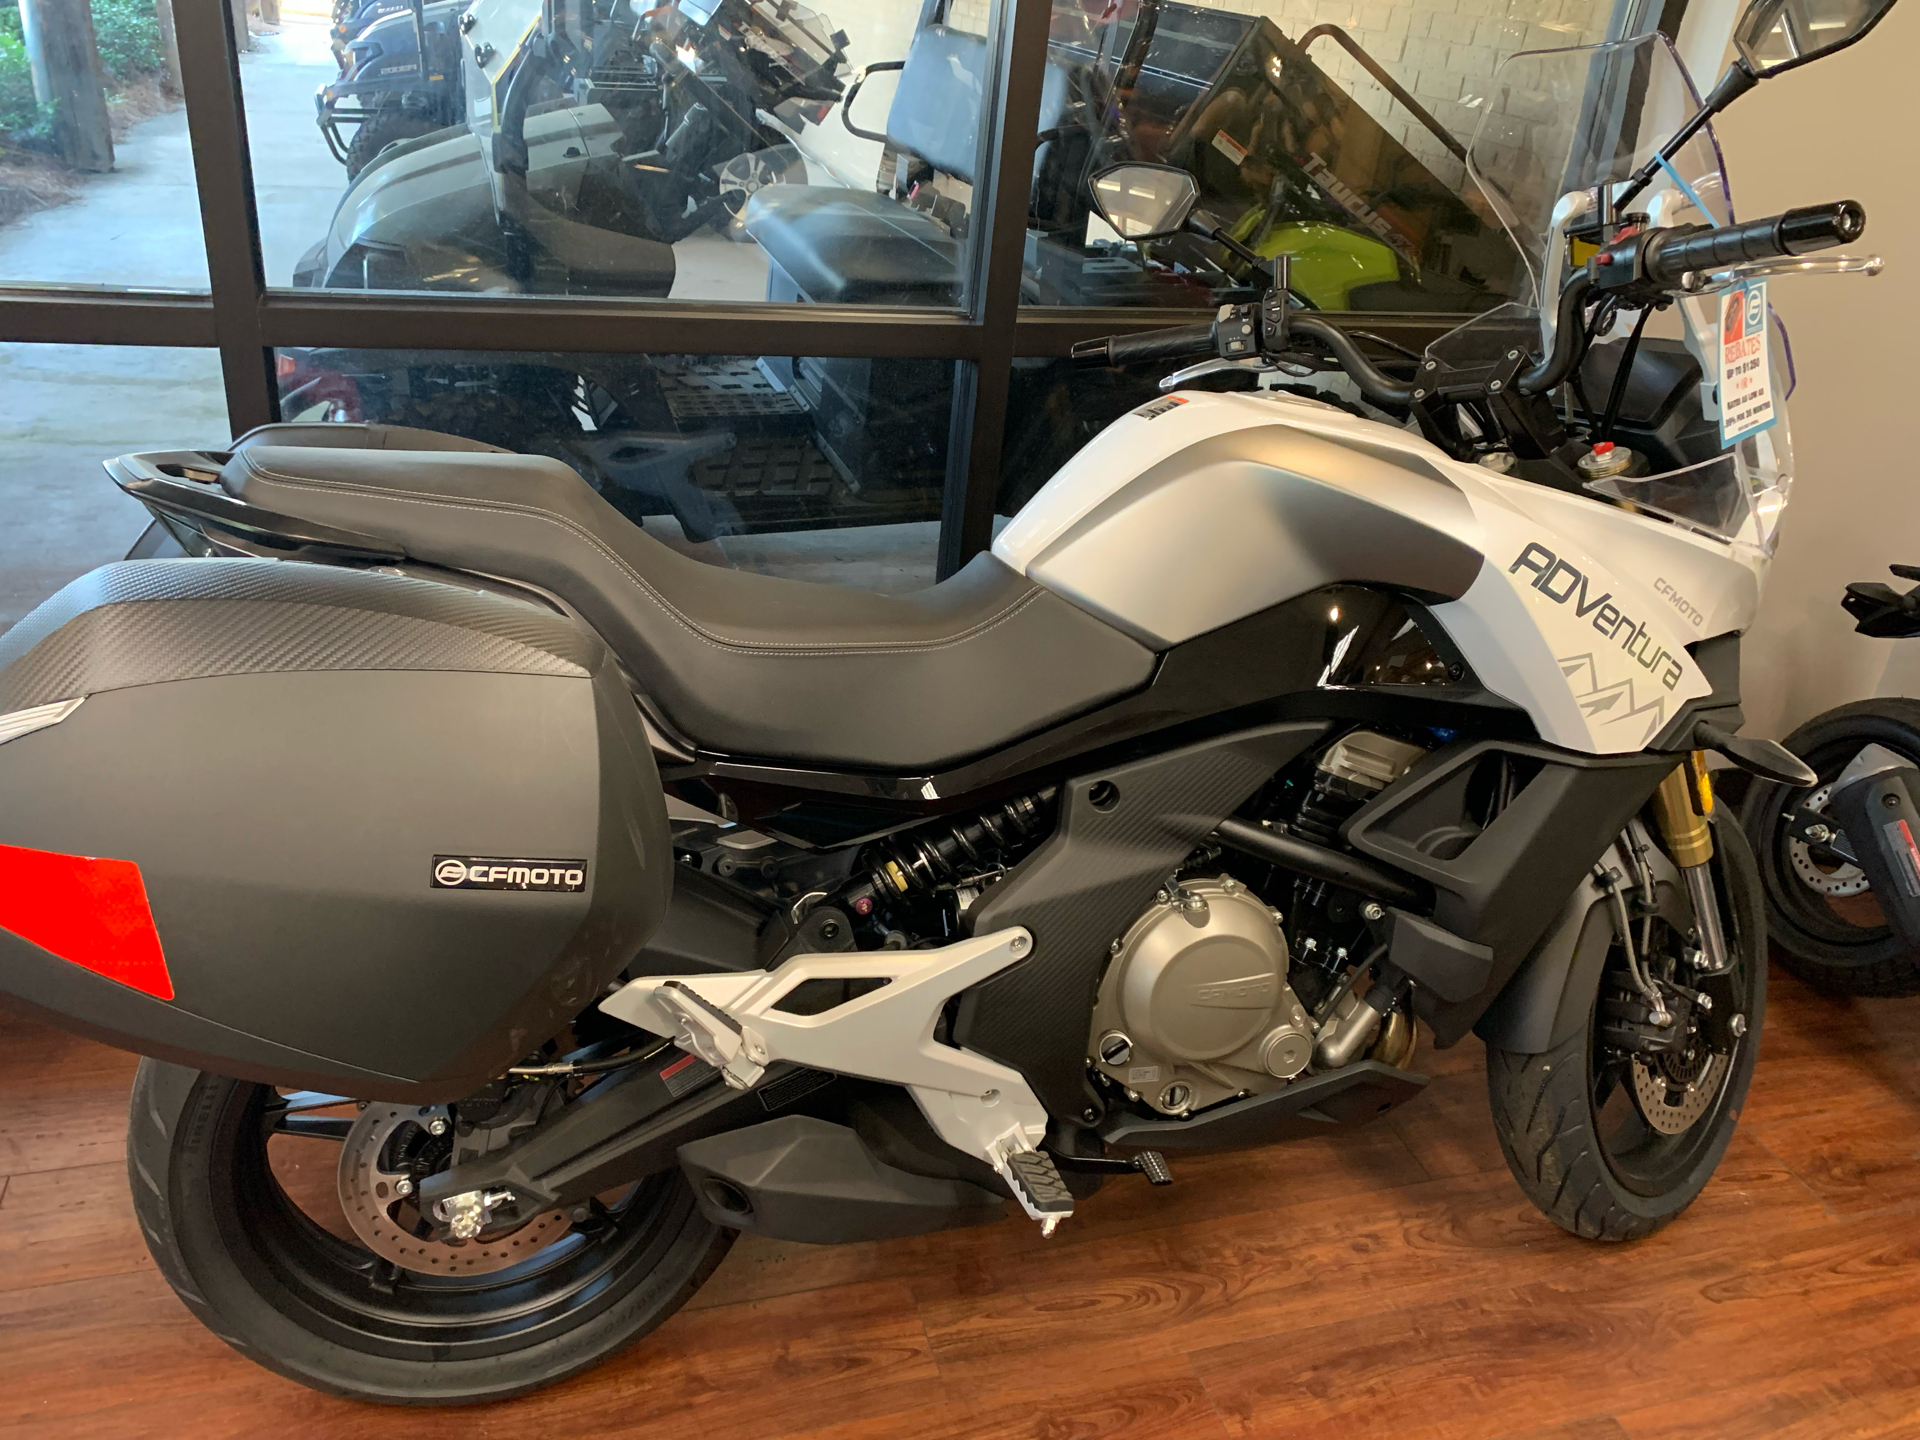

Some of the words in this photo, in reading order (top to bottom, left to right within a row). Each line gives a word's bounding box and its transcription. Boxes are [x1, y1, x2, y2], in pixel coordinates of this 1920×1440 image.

[1303, 151, 1392, 236] Taurus
[1725, 333, 1760, 364] REBATES
[1508, 541, 1683, 691] ADVentura
[1653, 577, 1704, 627] CFMOTO
[469, 865, 584, 886] CFMOTO
